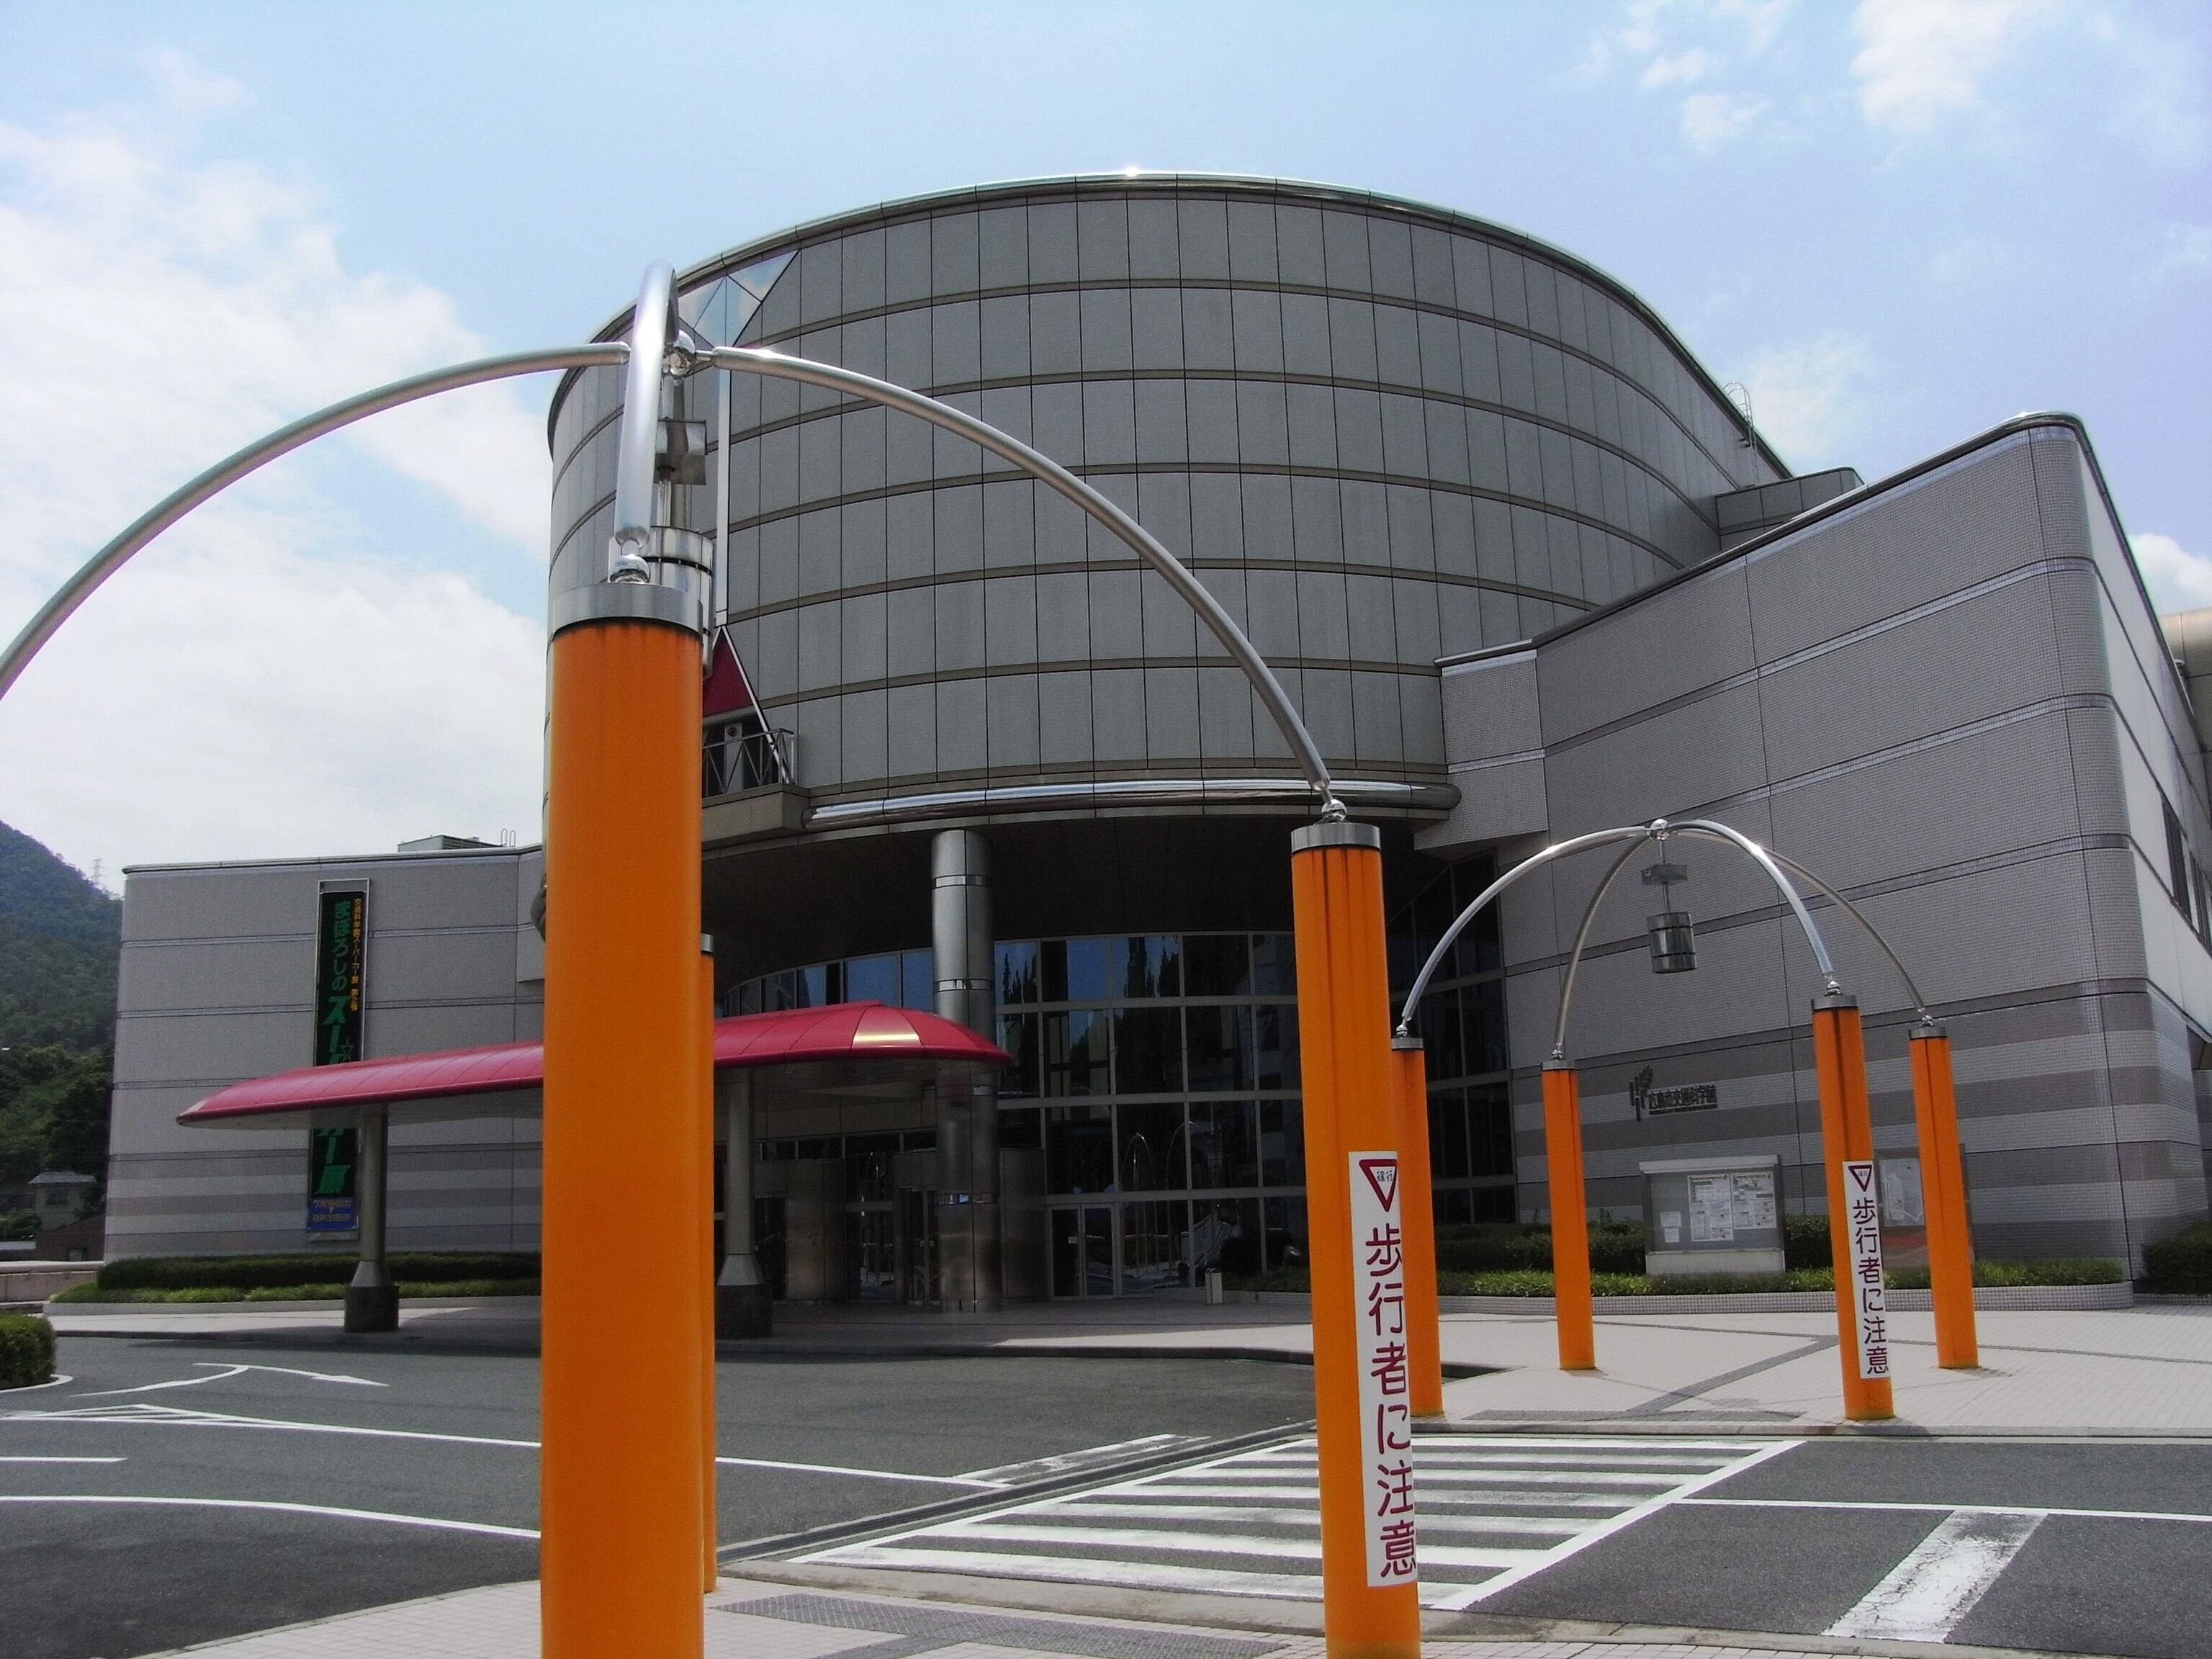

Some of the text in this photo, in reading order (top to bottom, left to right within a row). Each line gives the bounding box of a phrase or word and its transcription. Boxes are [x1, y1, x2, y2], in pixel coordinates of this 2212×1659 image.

[1376, 1170, 1393, 1182] 徐行
[1852, 1196, 1889, 1375] 歩行者に注意
[1365, 1223, 1416, 1578] 歩行者に注意
